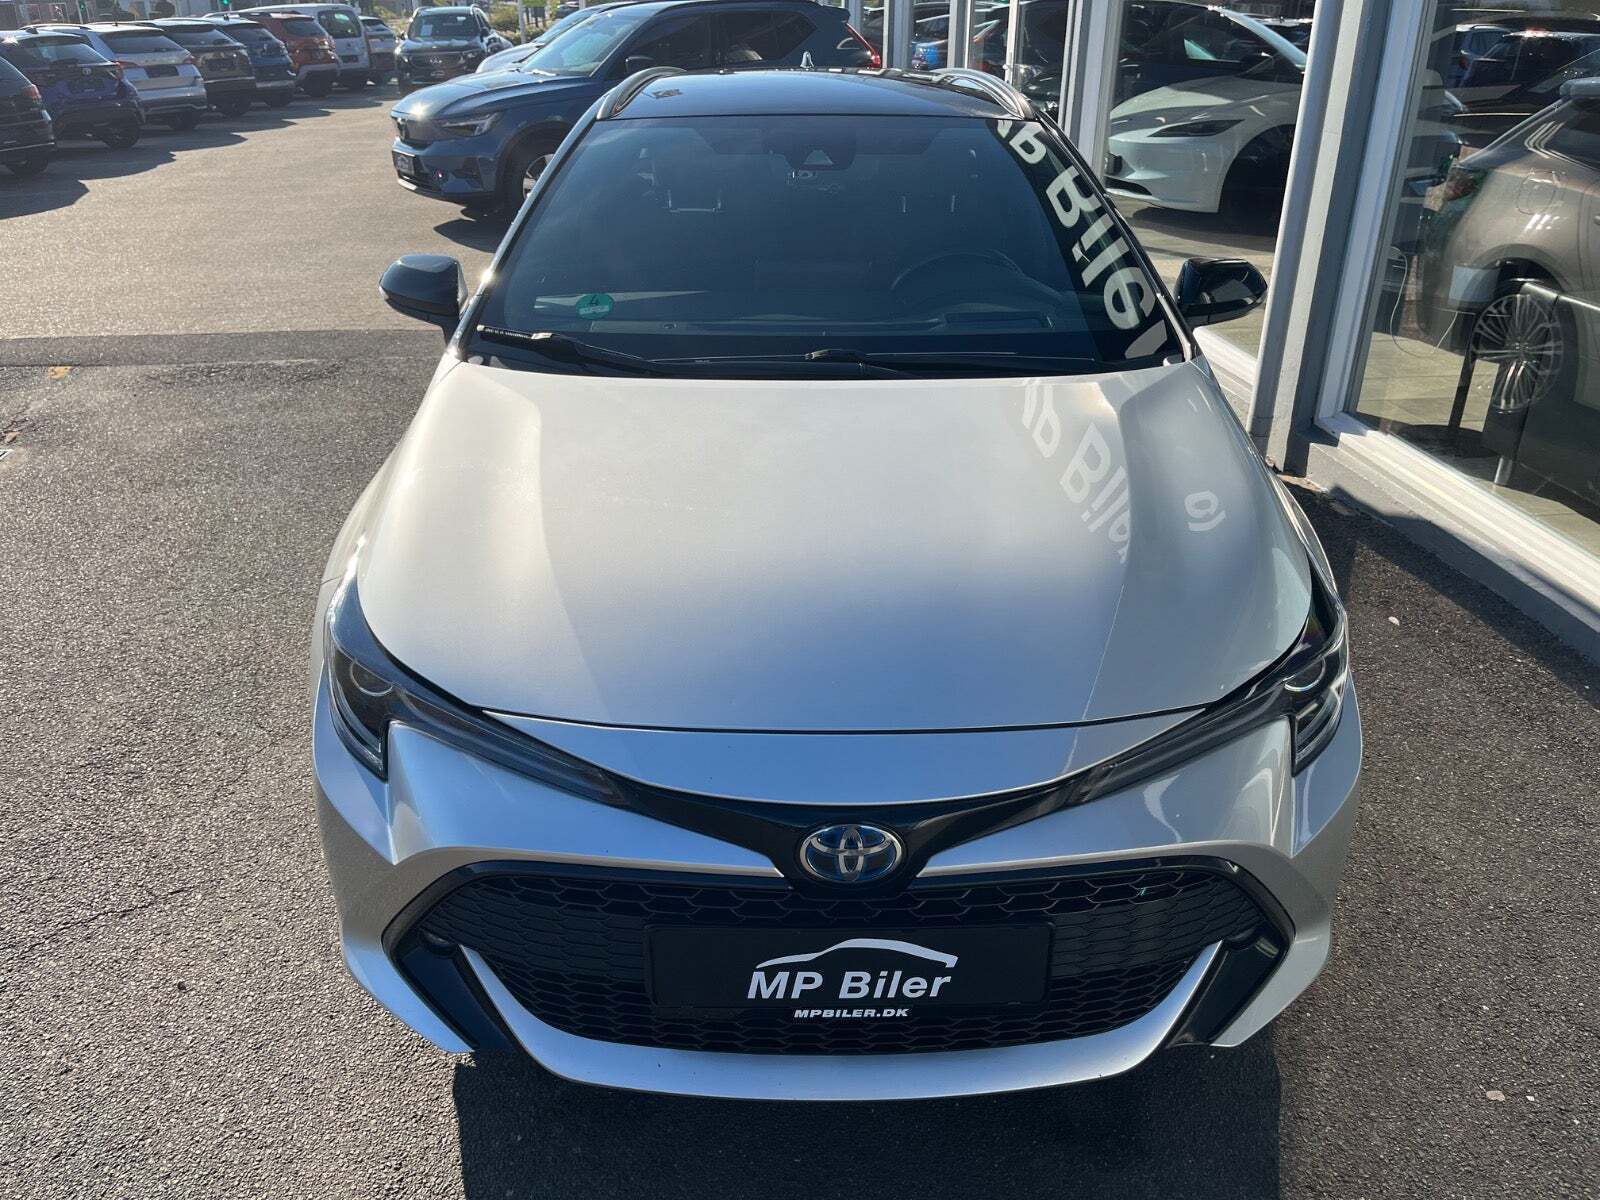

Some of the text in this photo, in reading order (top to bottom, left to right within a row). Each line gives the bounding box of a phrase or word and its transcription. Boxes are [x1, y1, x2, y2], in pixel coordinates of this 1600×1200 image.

[747, 970, 952, 999] MP Biler
[793, 1008, 910, 1018] MPBILER.DK
